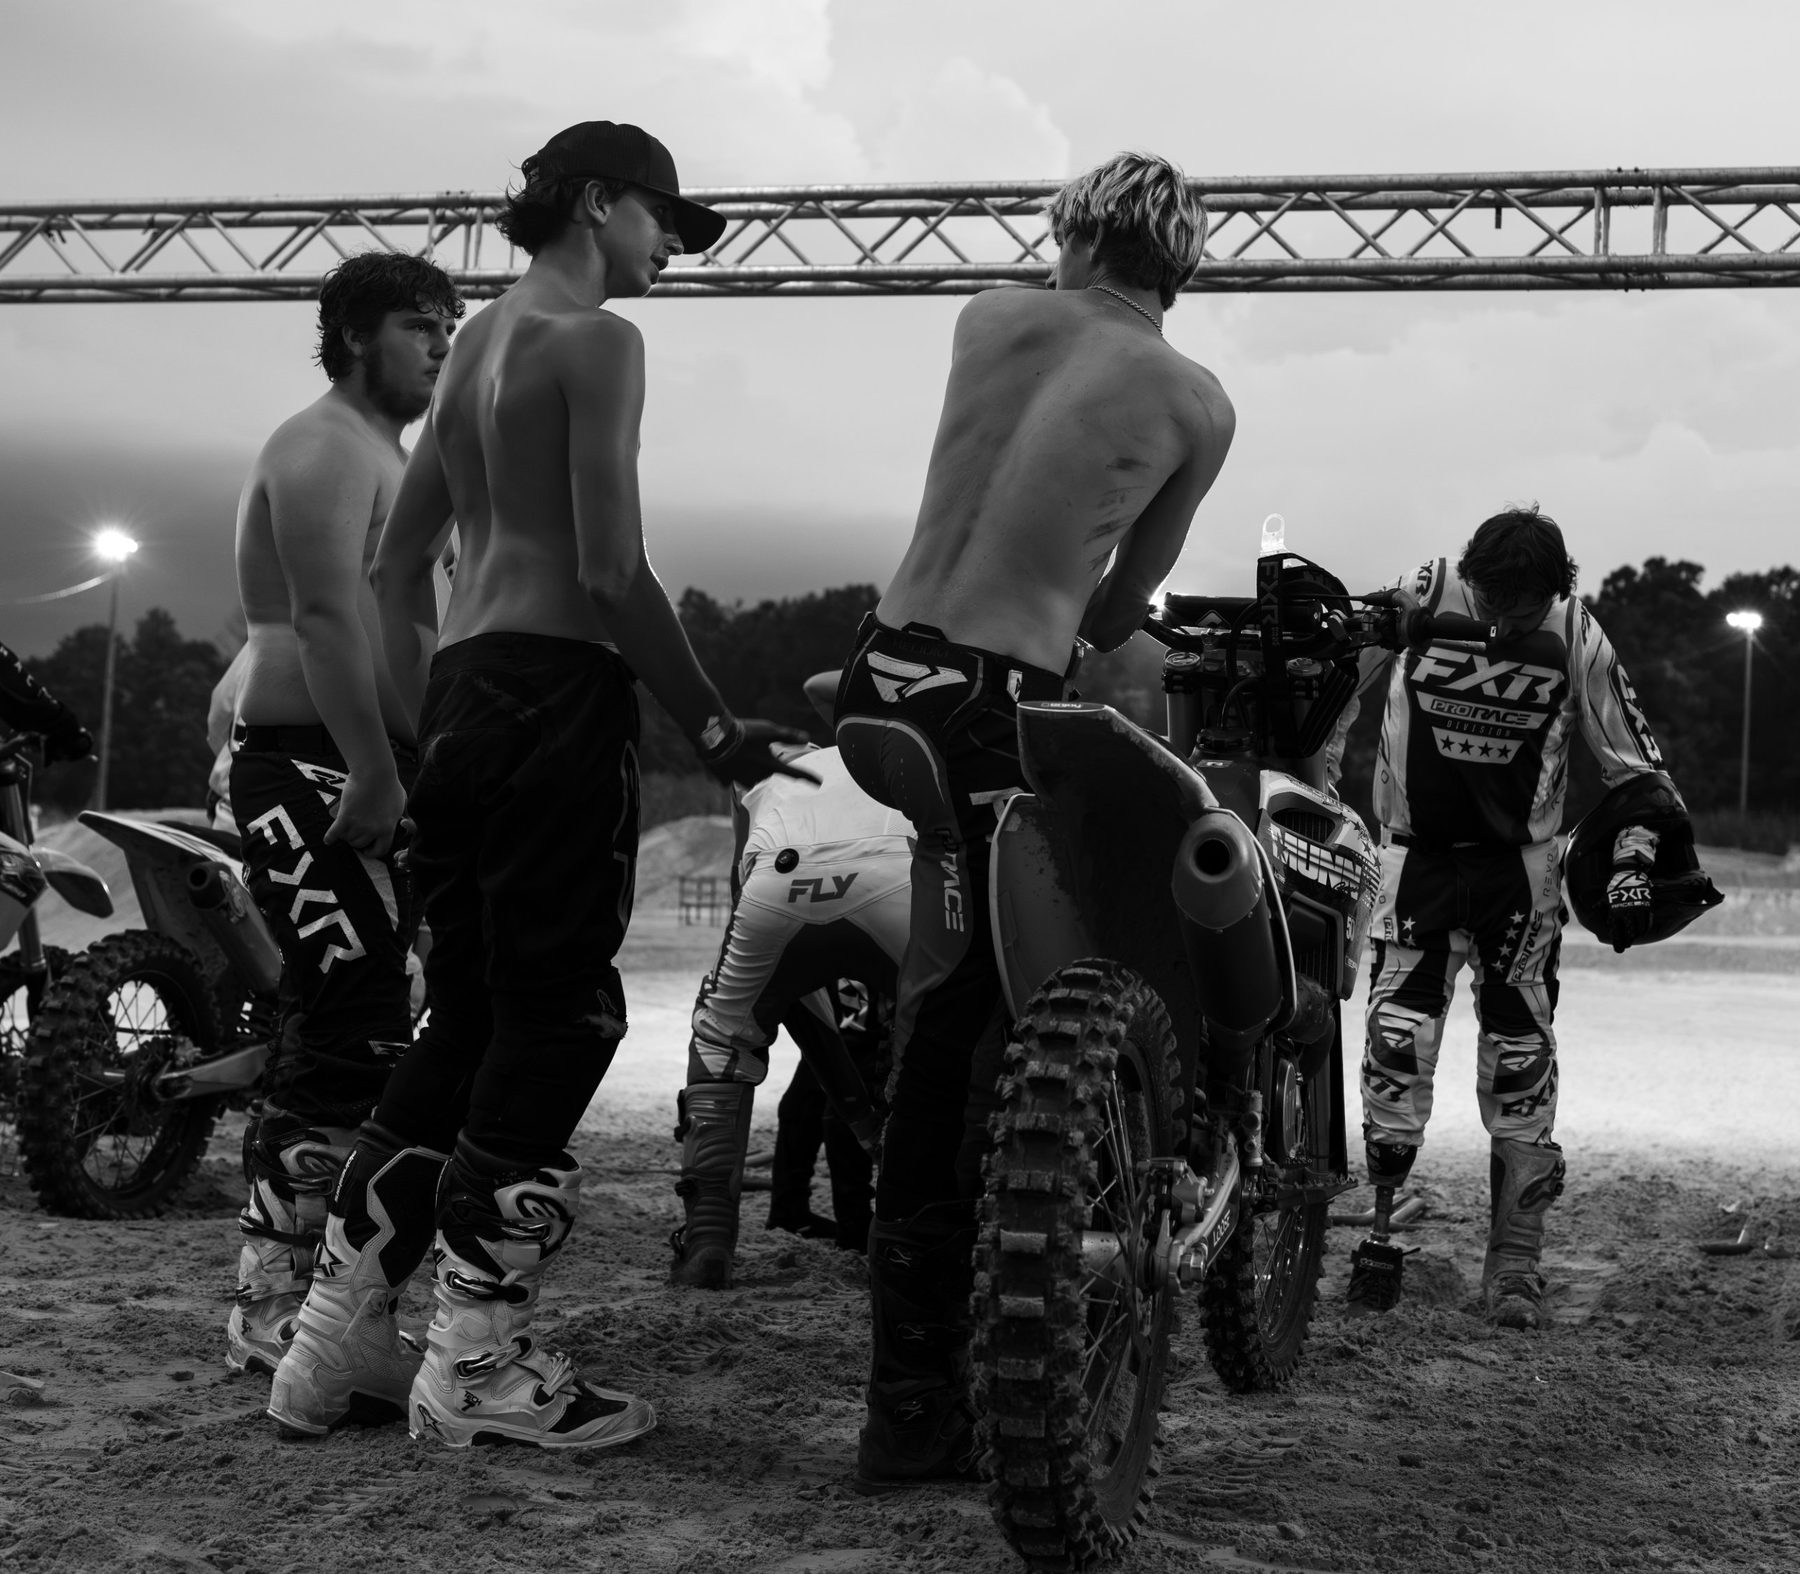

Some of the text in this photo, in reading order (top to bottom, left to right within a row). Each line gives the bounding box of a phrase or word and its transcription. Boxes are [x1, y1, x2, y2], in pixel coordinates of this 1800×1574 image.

[1410, 647, 1566, 705] FXR
[1446, 719, 1512, 737] DIVISION
[247, 804, 367, 974] FXR
[787, 872, 859, 903] FLY
[1543, 852, 1554, 898] REVO
[1608, 888, 1652, 904] FXR
